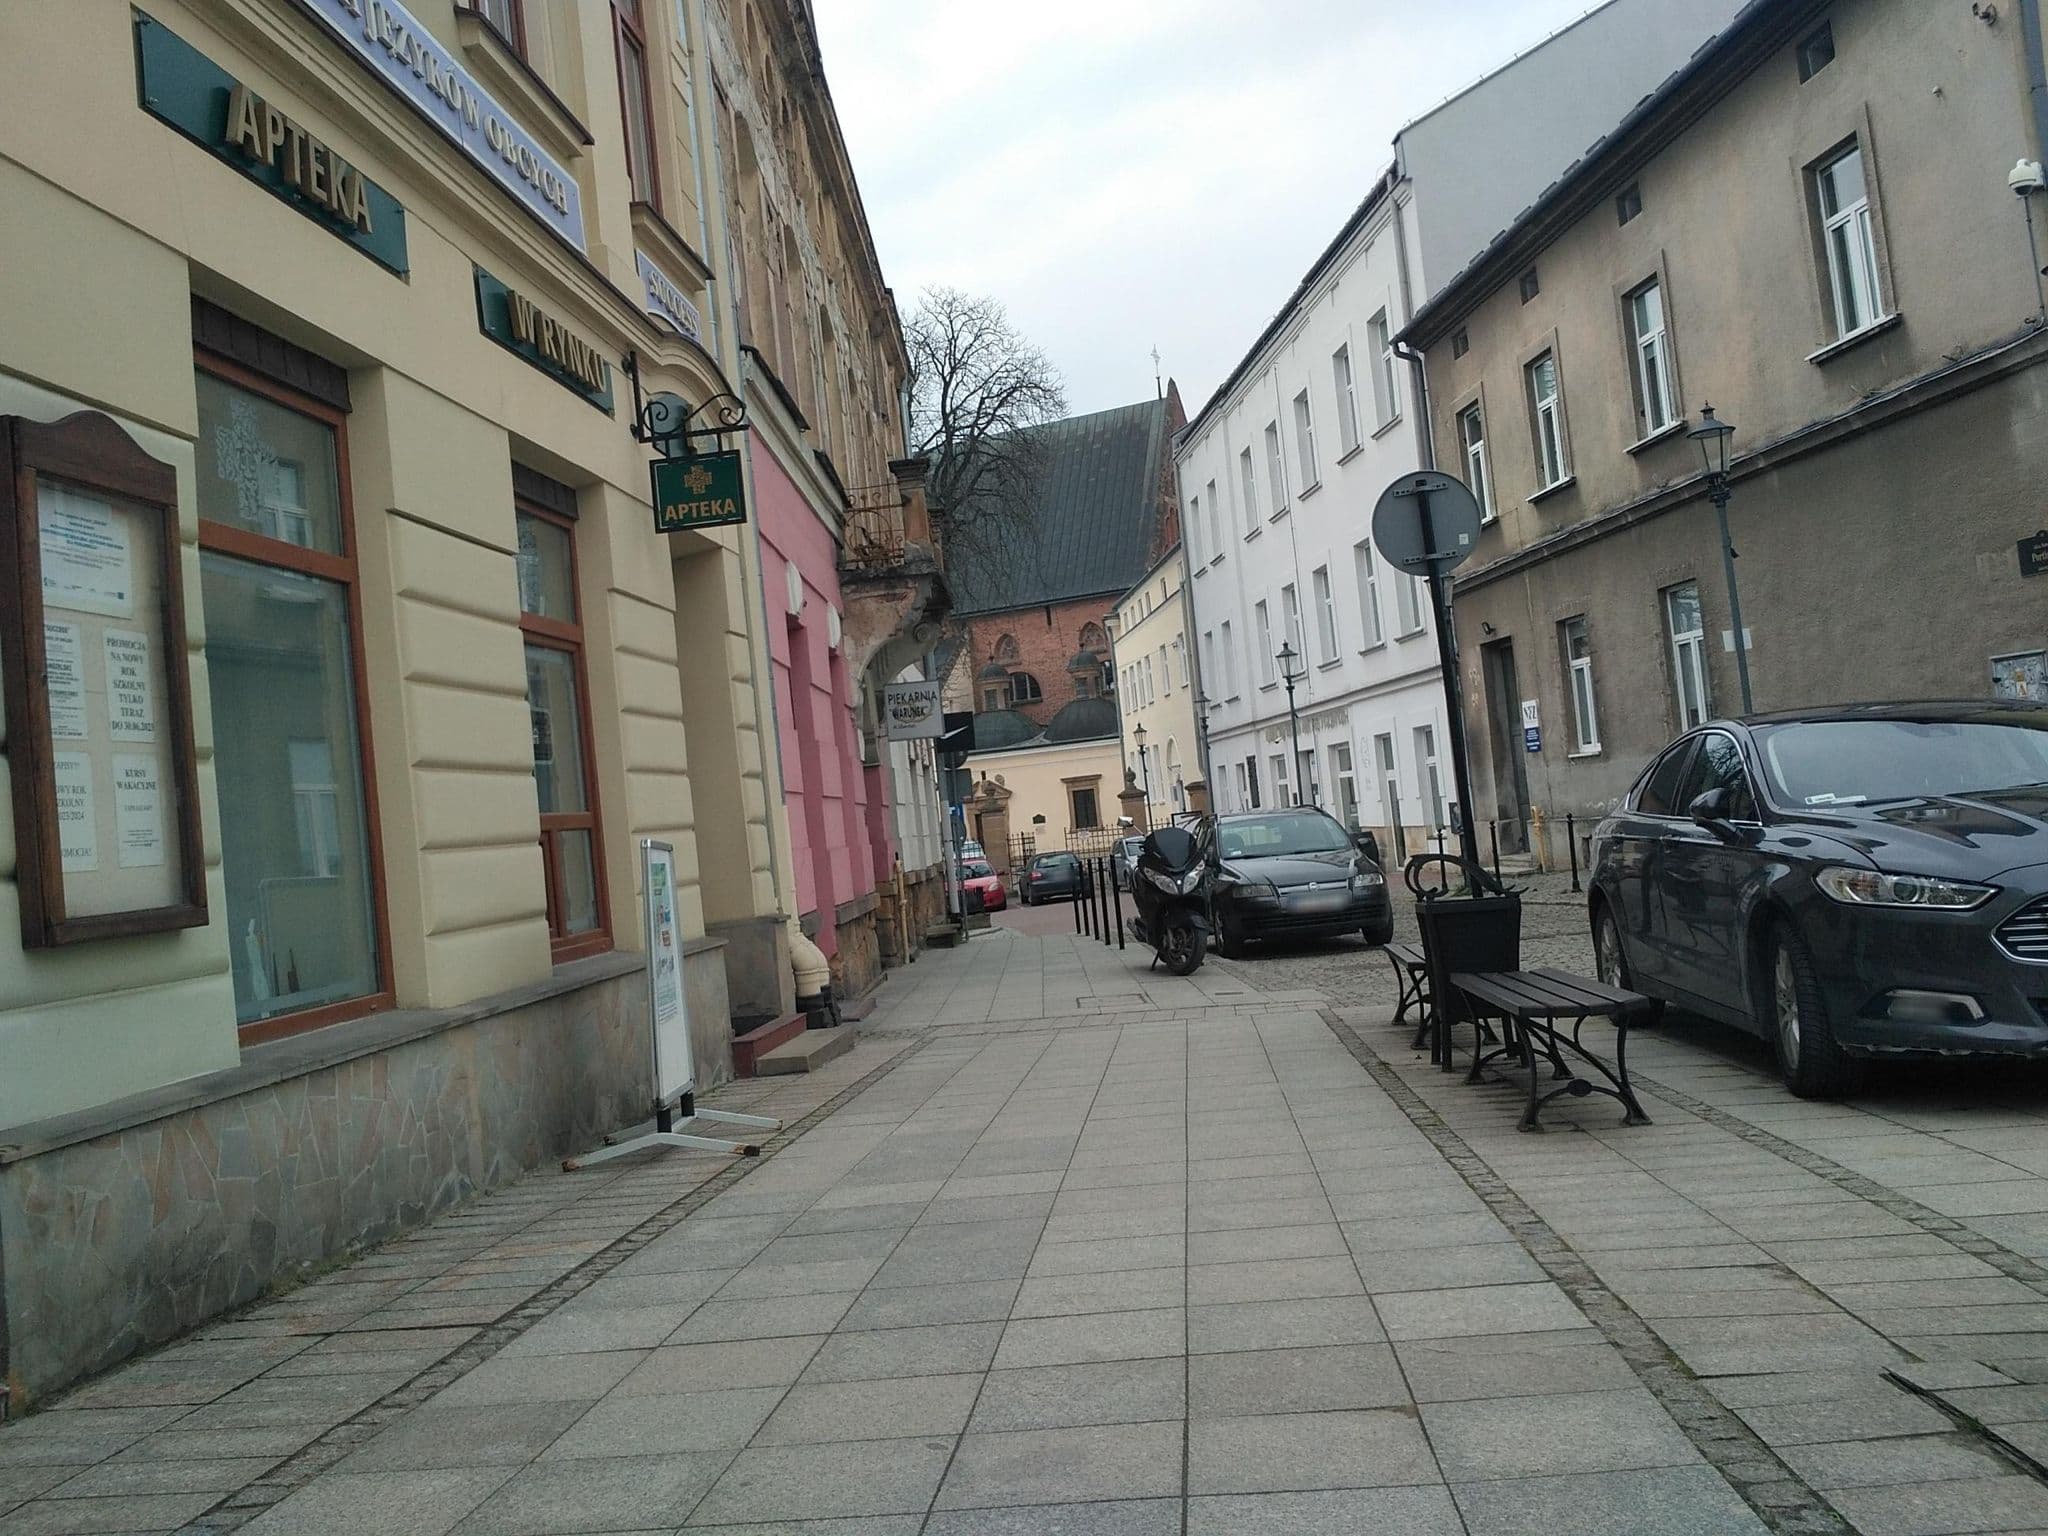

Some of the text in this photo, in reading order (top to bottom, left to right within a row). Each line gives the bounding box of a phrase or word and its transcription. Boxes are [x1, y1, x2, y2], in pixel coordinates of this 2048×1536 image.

[226, 84, 374, 235] APTEKA
[483, 113, 569, 216] OBCYCH
[508, 290, 607, 393] W RYNKU
[664, 497, 737, 522] APTEKA
[887, 690, 937, 704] PIEKARNIA
[125, 769, 146, 778] KURSY
